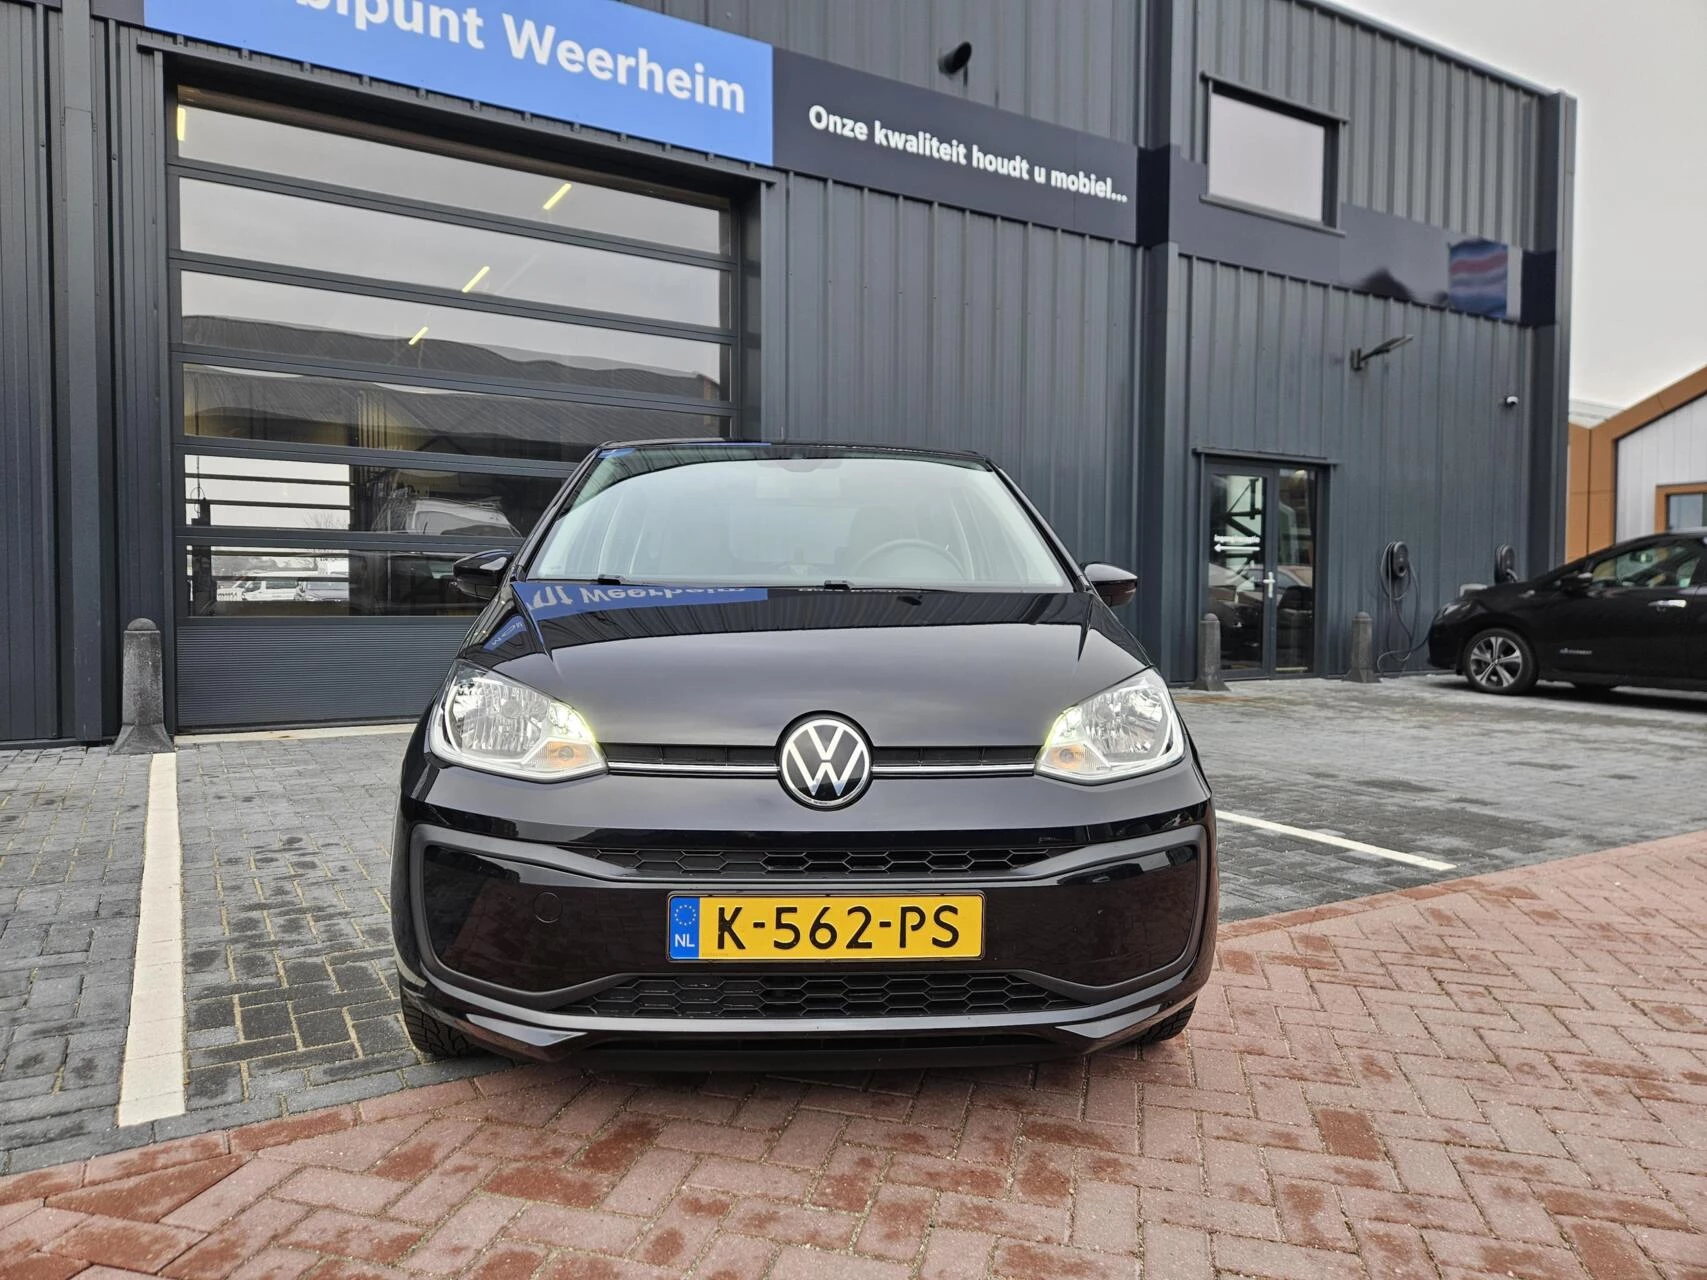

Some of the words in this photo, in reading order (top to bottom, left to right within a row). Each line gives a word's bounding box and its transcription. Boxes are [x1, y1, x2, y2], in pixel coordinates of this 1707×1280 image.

[501, 13, 746, 114] Weerheim
[808, 105, 869, 141] Onze
[874, 120, 968, 166] kwaliteit
[972, 145, 1030, 181] houdt
[1034, 165, 1046, 185] u
[1051, 169, 1128, 203] mobiel...
[674, 933, 695, 948] NL
[716, 905, 960, 950] K-562-PS
